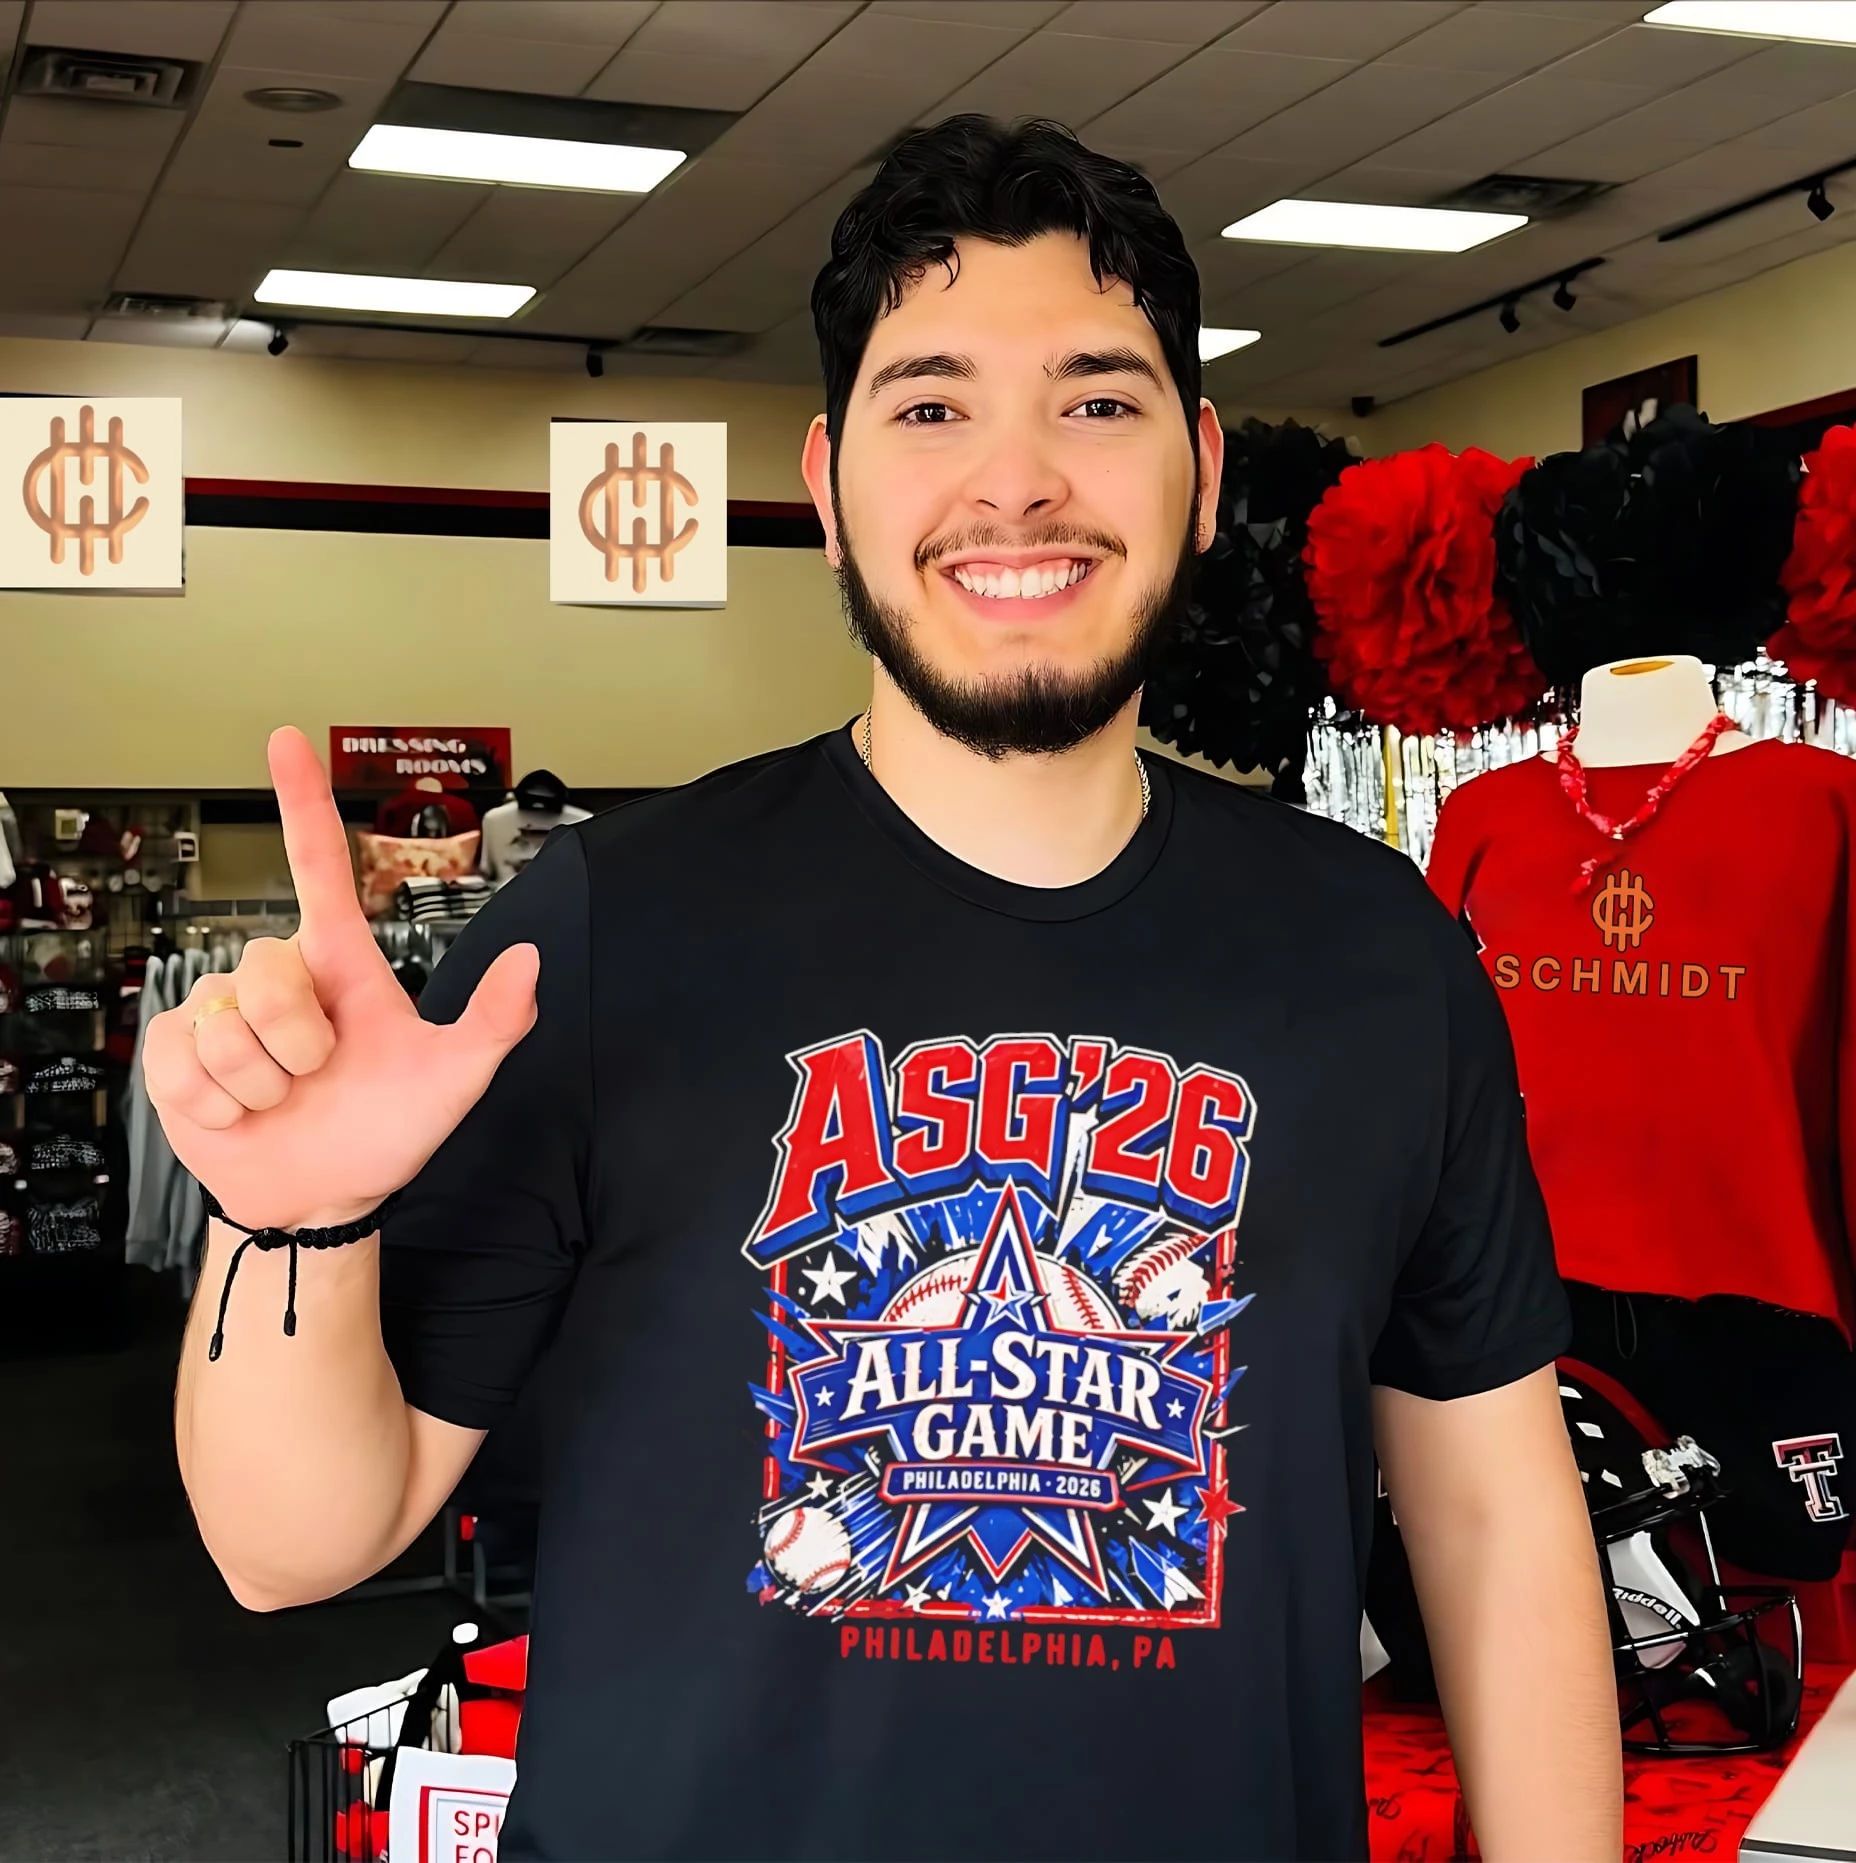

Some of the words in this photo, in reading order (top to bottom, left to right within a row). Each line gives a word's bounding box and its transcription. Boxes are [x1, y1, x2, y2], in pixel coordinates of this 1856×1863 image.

[1494, 954, 1746, 1000] SCHMIDT
[839, 1331, 1163, 1430] ALL-STAR
[913, 1403, 1093, 1467] GAME
[902, 1470, 1041, 1493] PHILADELPHIA
[1056, 1475, 1101, 1498] 2026
[840, 1626, 1120, 1671] PHILADELPHIA,
[1133, 1635, 1176, 1670] PA
